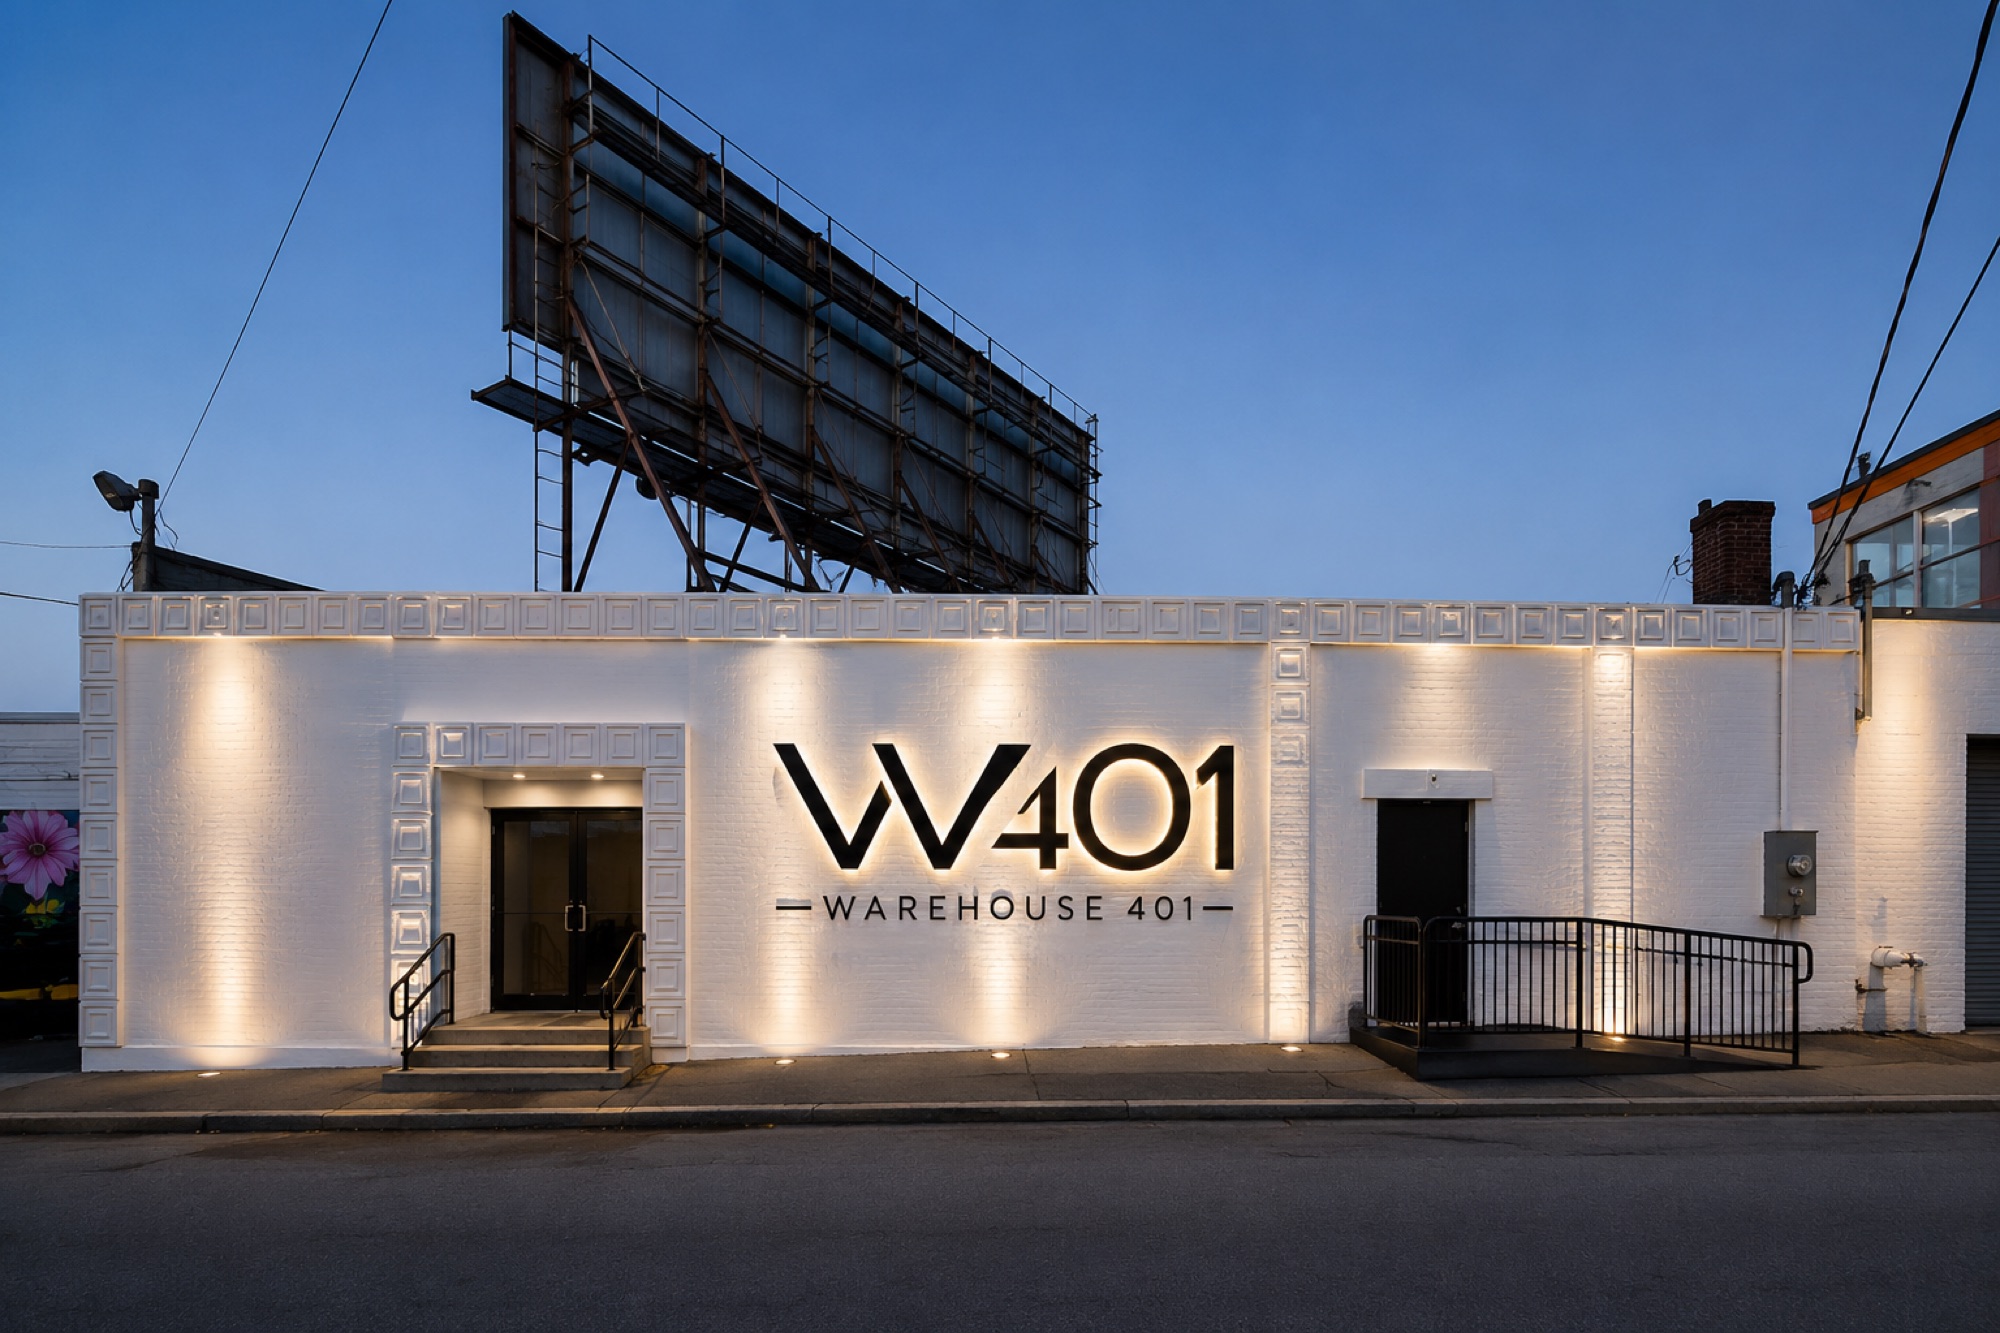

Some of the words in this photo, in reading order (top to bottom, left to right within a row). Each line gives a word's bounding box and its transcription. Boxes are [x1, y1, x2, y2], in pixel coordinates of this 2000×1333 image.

[773, 742, 1235, 871] W401
[822, 895, 1103, 921] WAREHOUSE
[1127, 895, 1193, 921] 401
